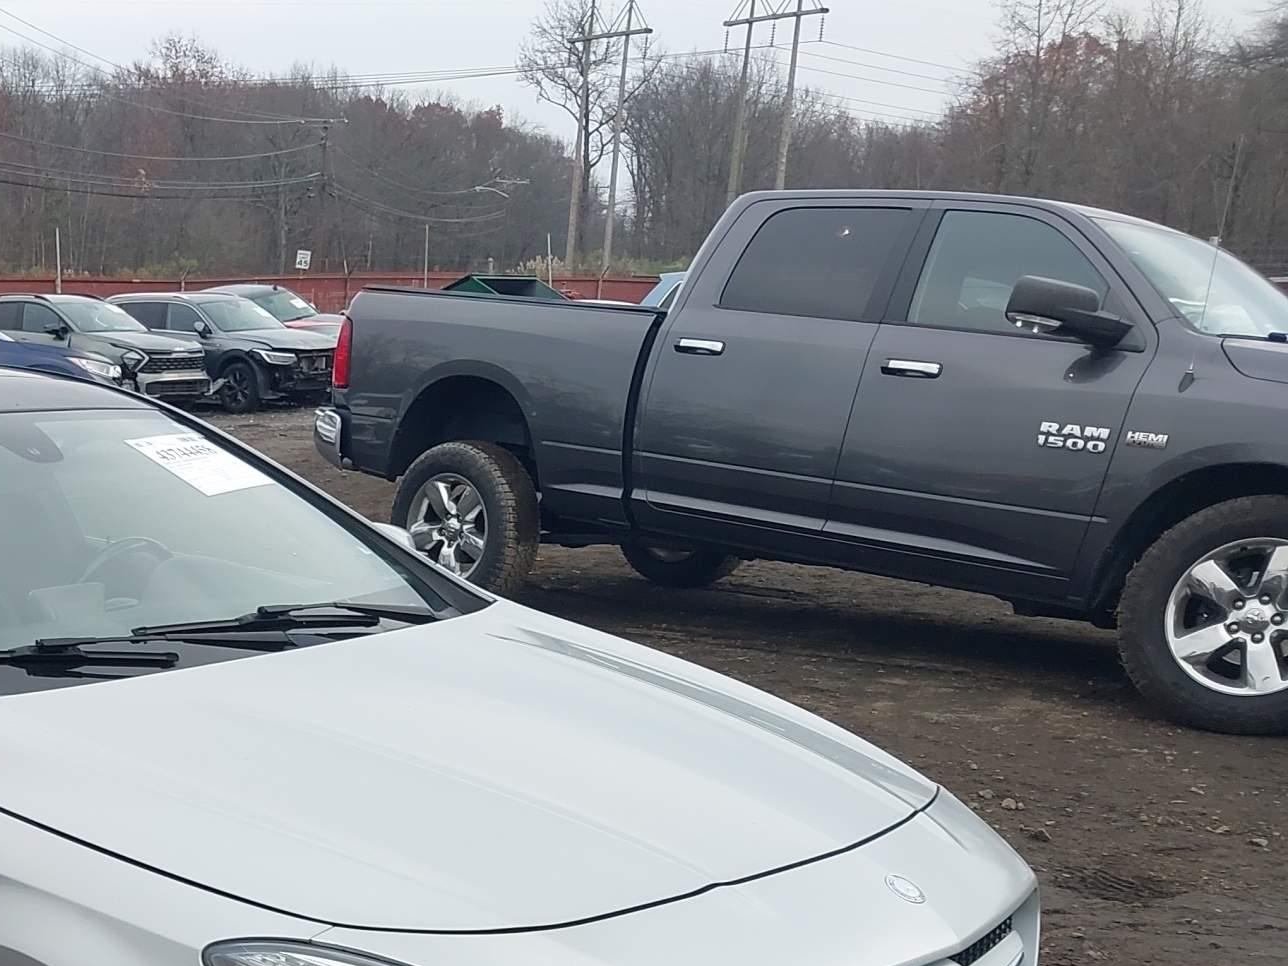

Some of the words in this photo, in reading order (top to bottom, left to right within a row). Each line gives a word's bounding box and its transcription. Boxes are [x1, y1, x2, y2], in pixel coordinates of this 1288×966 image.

[298, 260, 309, 268] 45
[1040, 422, 1111, 439] RAM
[1127, 431, 1169, 442] HEMI
[1037, 435, 1106, 453] 1500
